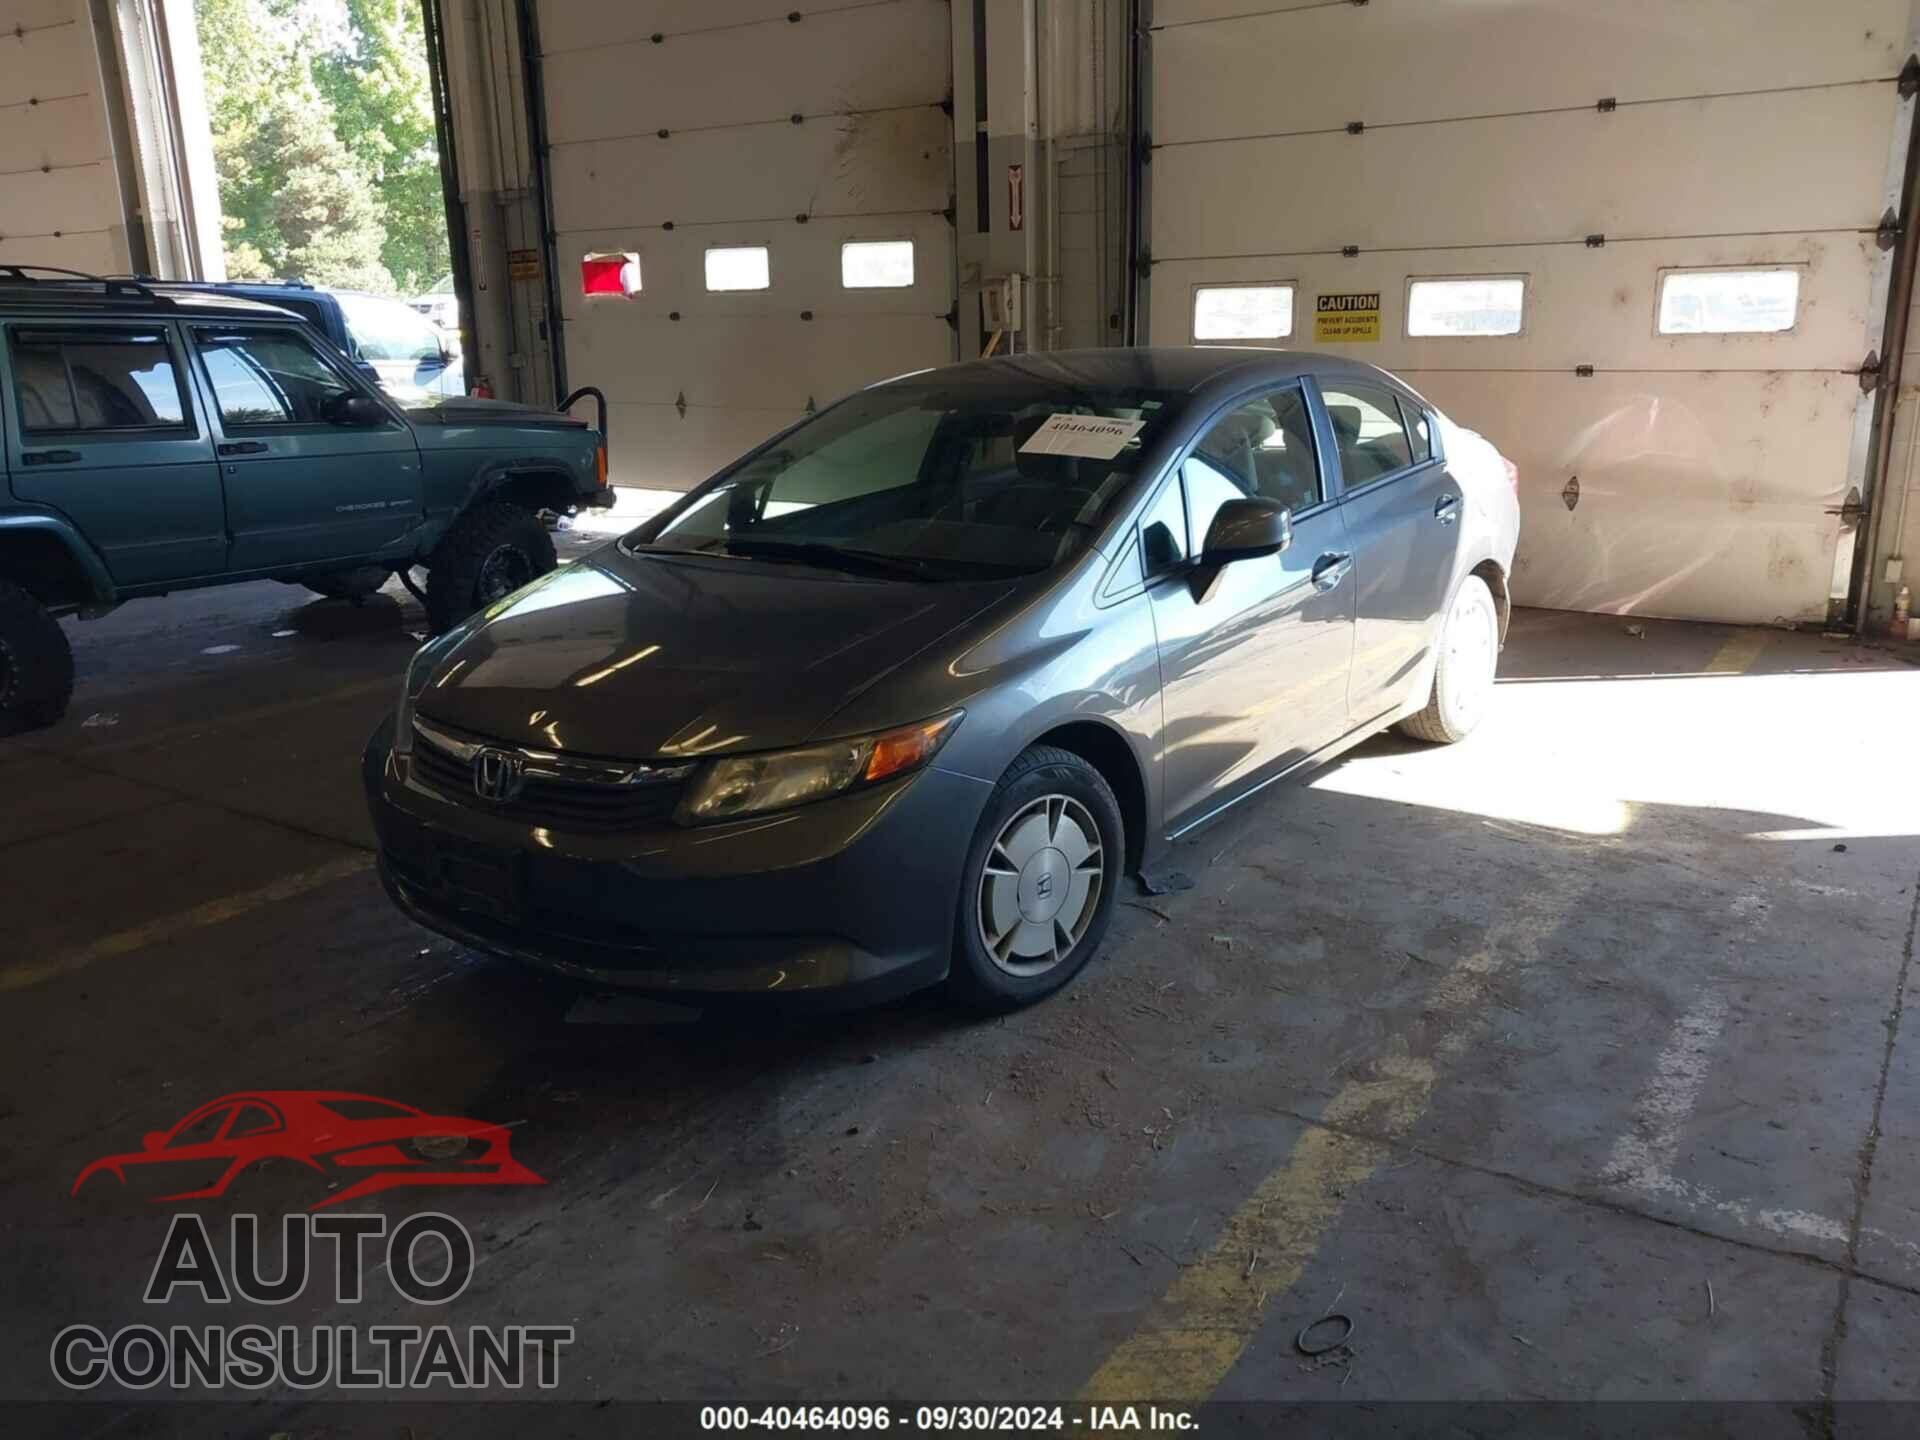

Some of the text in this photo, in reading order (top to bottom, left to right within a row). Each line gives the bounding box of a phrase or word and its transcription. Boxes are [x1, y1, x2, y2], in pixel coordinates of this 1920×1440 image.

[1319, 295, 1378, 310] CAUTION
[1318, 316, 1344, 324] PREVENT
[1322, 327, 1341, 335] CLEAN
[1342, 327, 1351, 335] UP
[1051, 422, 1124, 435] 40464096
